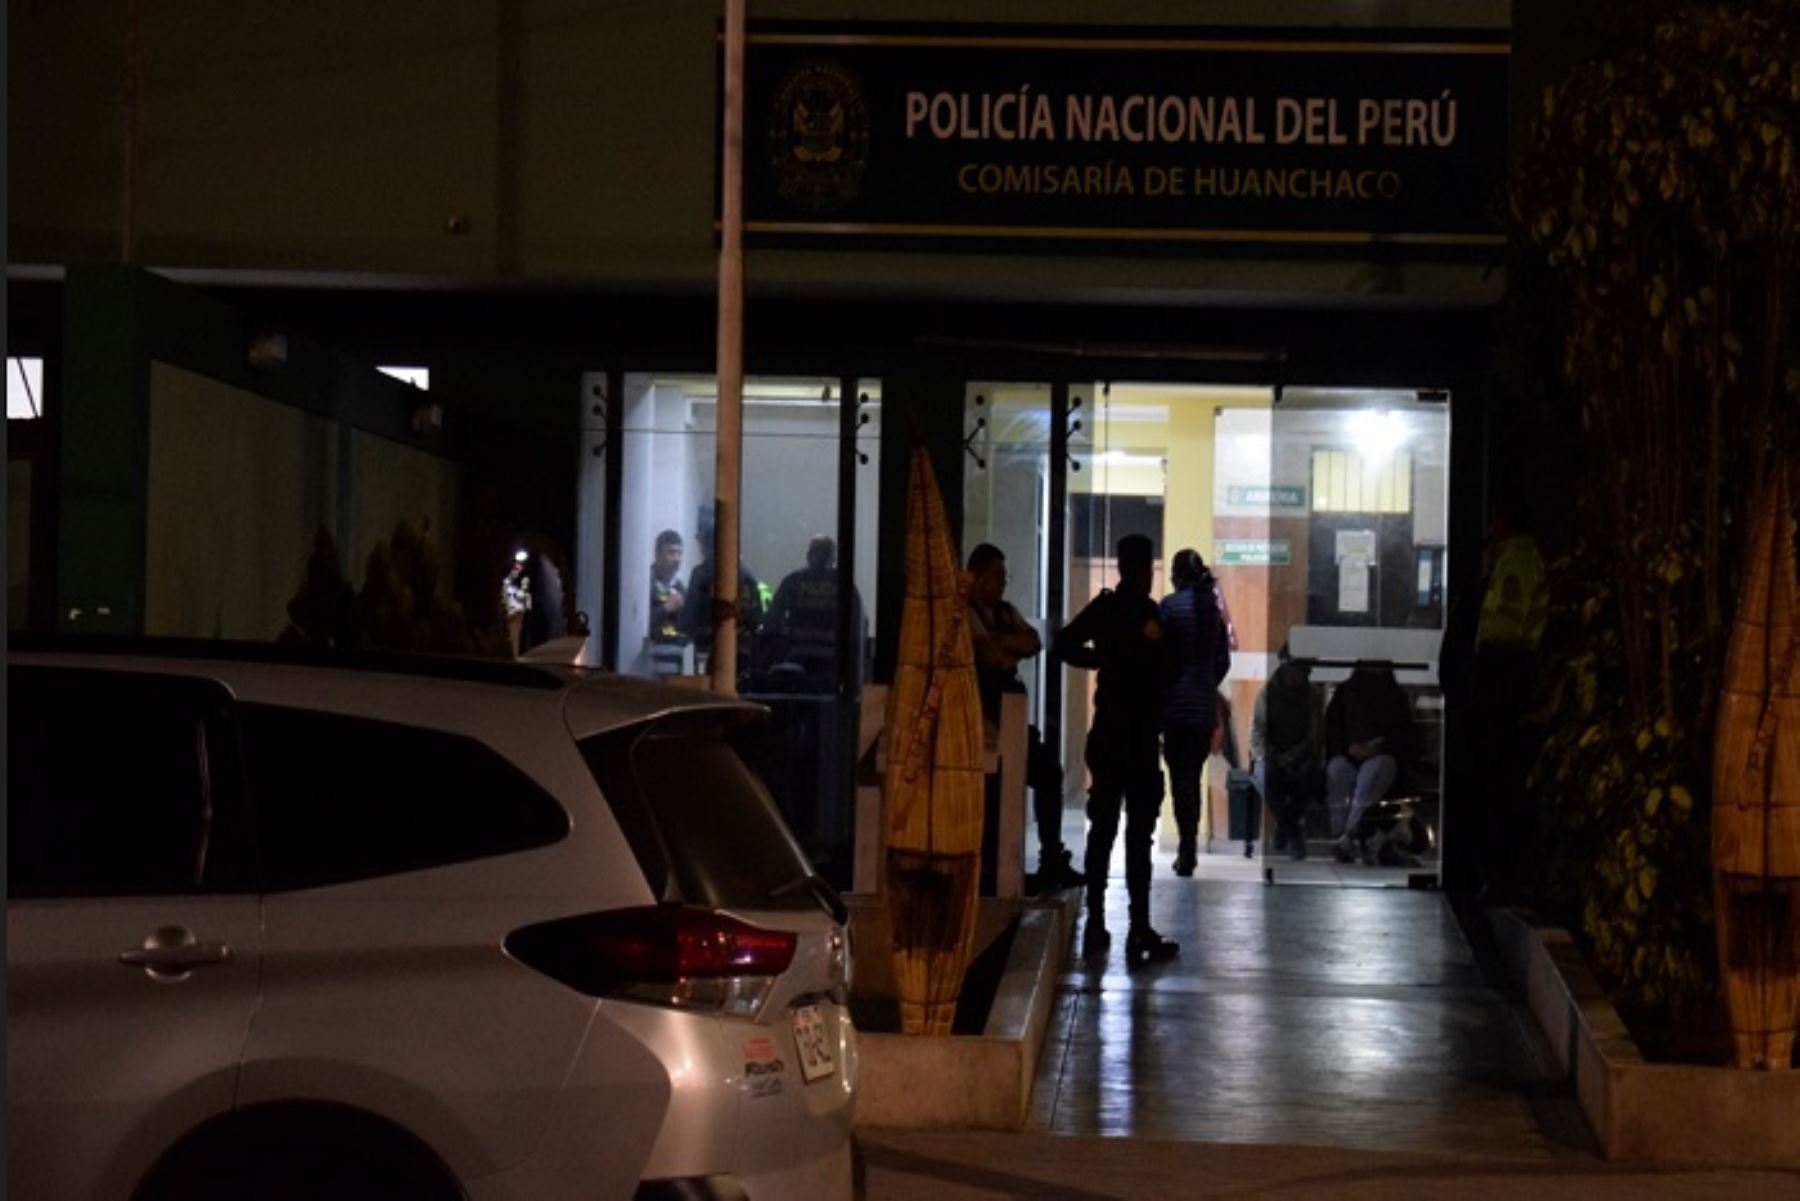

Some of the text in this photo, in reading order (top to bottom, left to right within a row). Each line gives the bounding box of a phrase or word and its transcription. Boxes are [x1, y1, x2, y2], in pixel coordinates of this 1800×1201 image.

[904, 82, 1458, 148] POLICÍA NACIONAL DEL PERÚ
[957, 159, 1401, 199] COMISARÍA DE HUANCHACO
